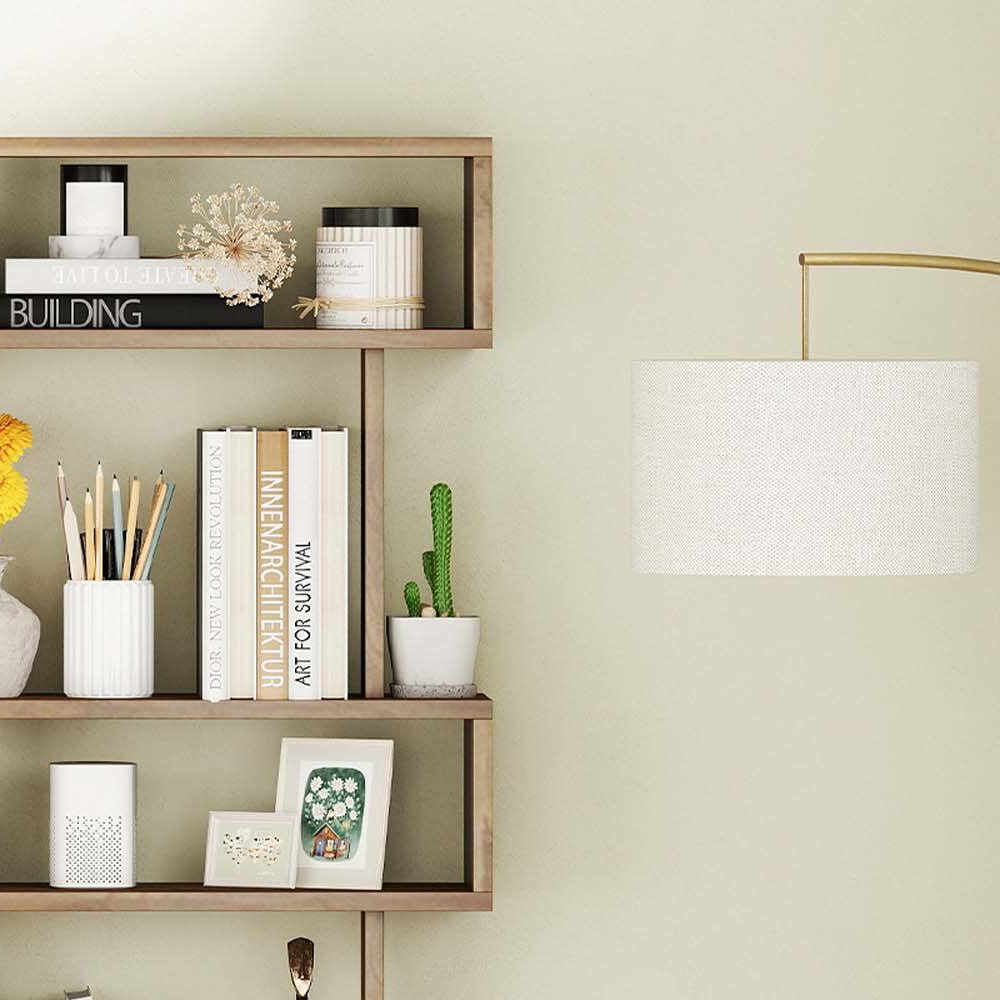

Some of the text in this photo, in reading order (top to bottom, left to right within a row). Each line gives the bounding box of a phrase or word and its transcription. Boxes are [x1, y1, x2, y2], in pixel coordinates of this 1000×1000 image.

[54, 266, 97, 286] LIVE
[104, 266, 129, 286] TO
[10, 297, 142, 329] BUILDING
[208, 445, 223, 550] REVOLUTION
[208, 554, 223, 601] LOOK
[260, 470, 284, 688] INNENARCHITEKTUR
[208, 604, 223, 642] NEW
[294, 541, 312, 687] ART FOR SURVIVAL
